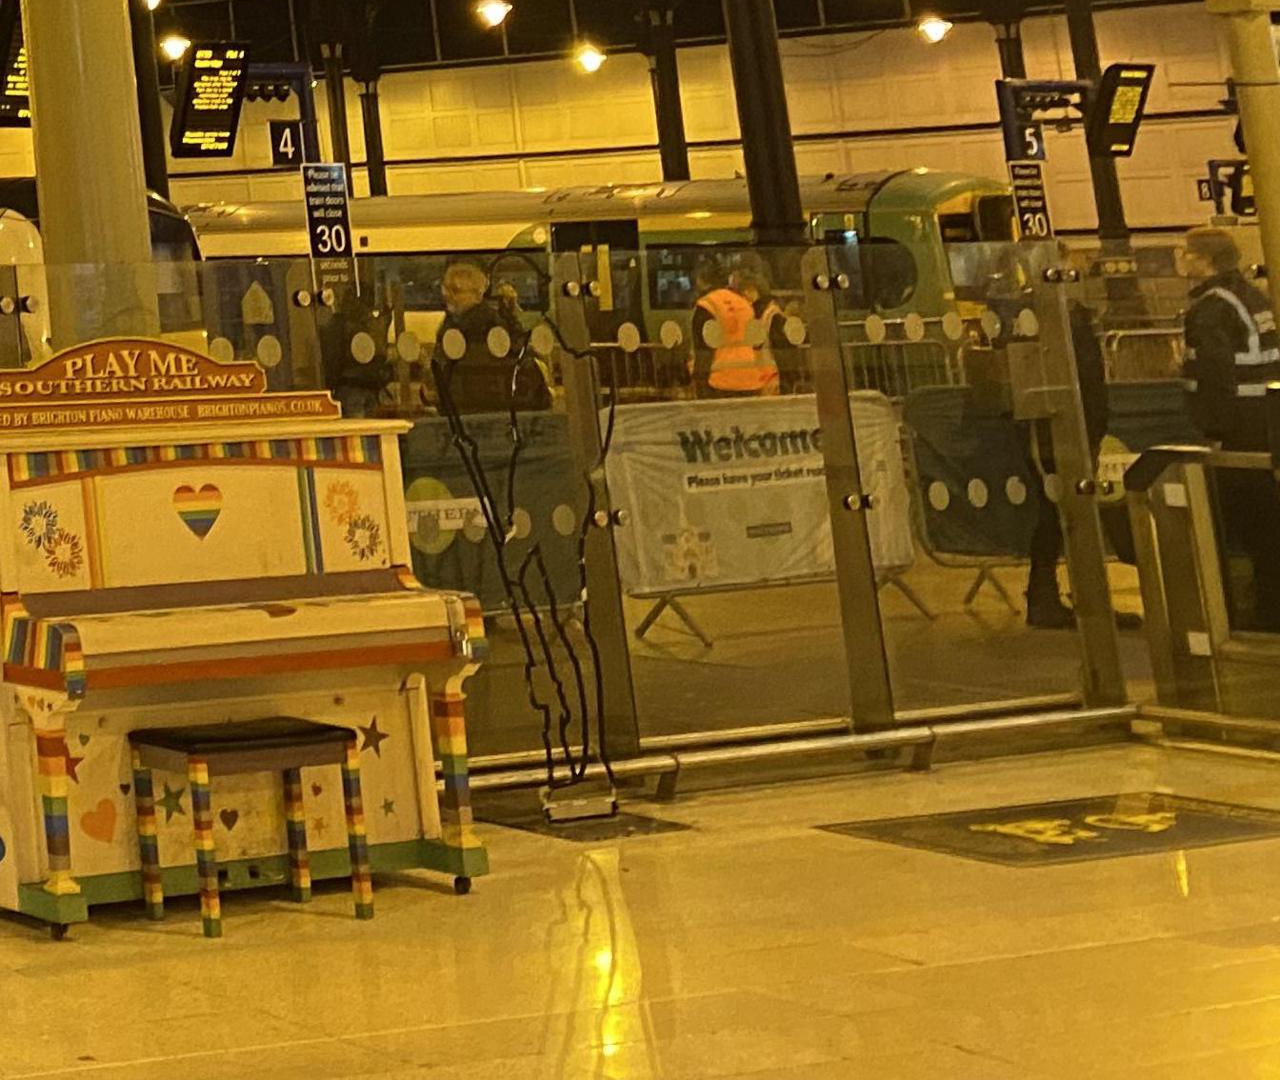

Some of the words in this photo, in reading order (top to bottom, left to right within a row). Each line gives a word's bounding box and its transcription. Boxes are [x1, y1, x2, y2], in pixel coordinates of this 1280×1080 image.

[279, 127, 296, 159] 4
[1024, 128, 1039, 156] 5
[309, 196, 325, 206] train
[326, 196, 345, 206] doors
[313, 210, 325, 219] will
[325, 209, 343, 219] close
[1023, 213, 1047, 237] 30
[316, 224, 346, 253] 30
[64, 351, 140, 379] PLAY
[149, 351, 199, 376] ME
[153, 373, 255, 392] RAILWAY
[13, 412, 29, 427] BY
[32, 408, 87, 426] BRIGHTON
[89, 408, 123, 424] PIANO
[126, 405, 191, 422] WAREHOUSE
[688, 475, 721, 489] Please
[750, 472, 773, 487] your
